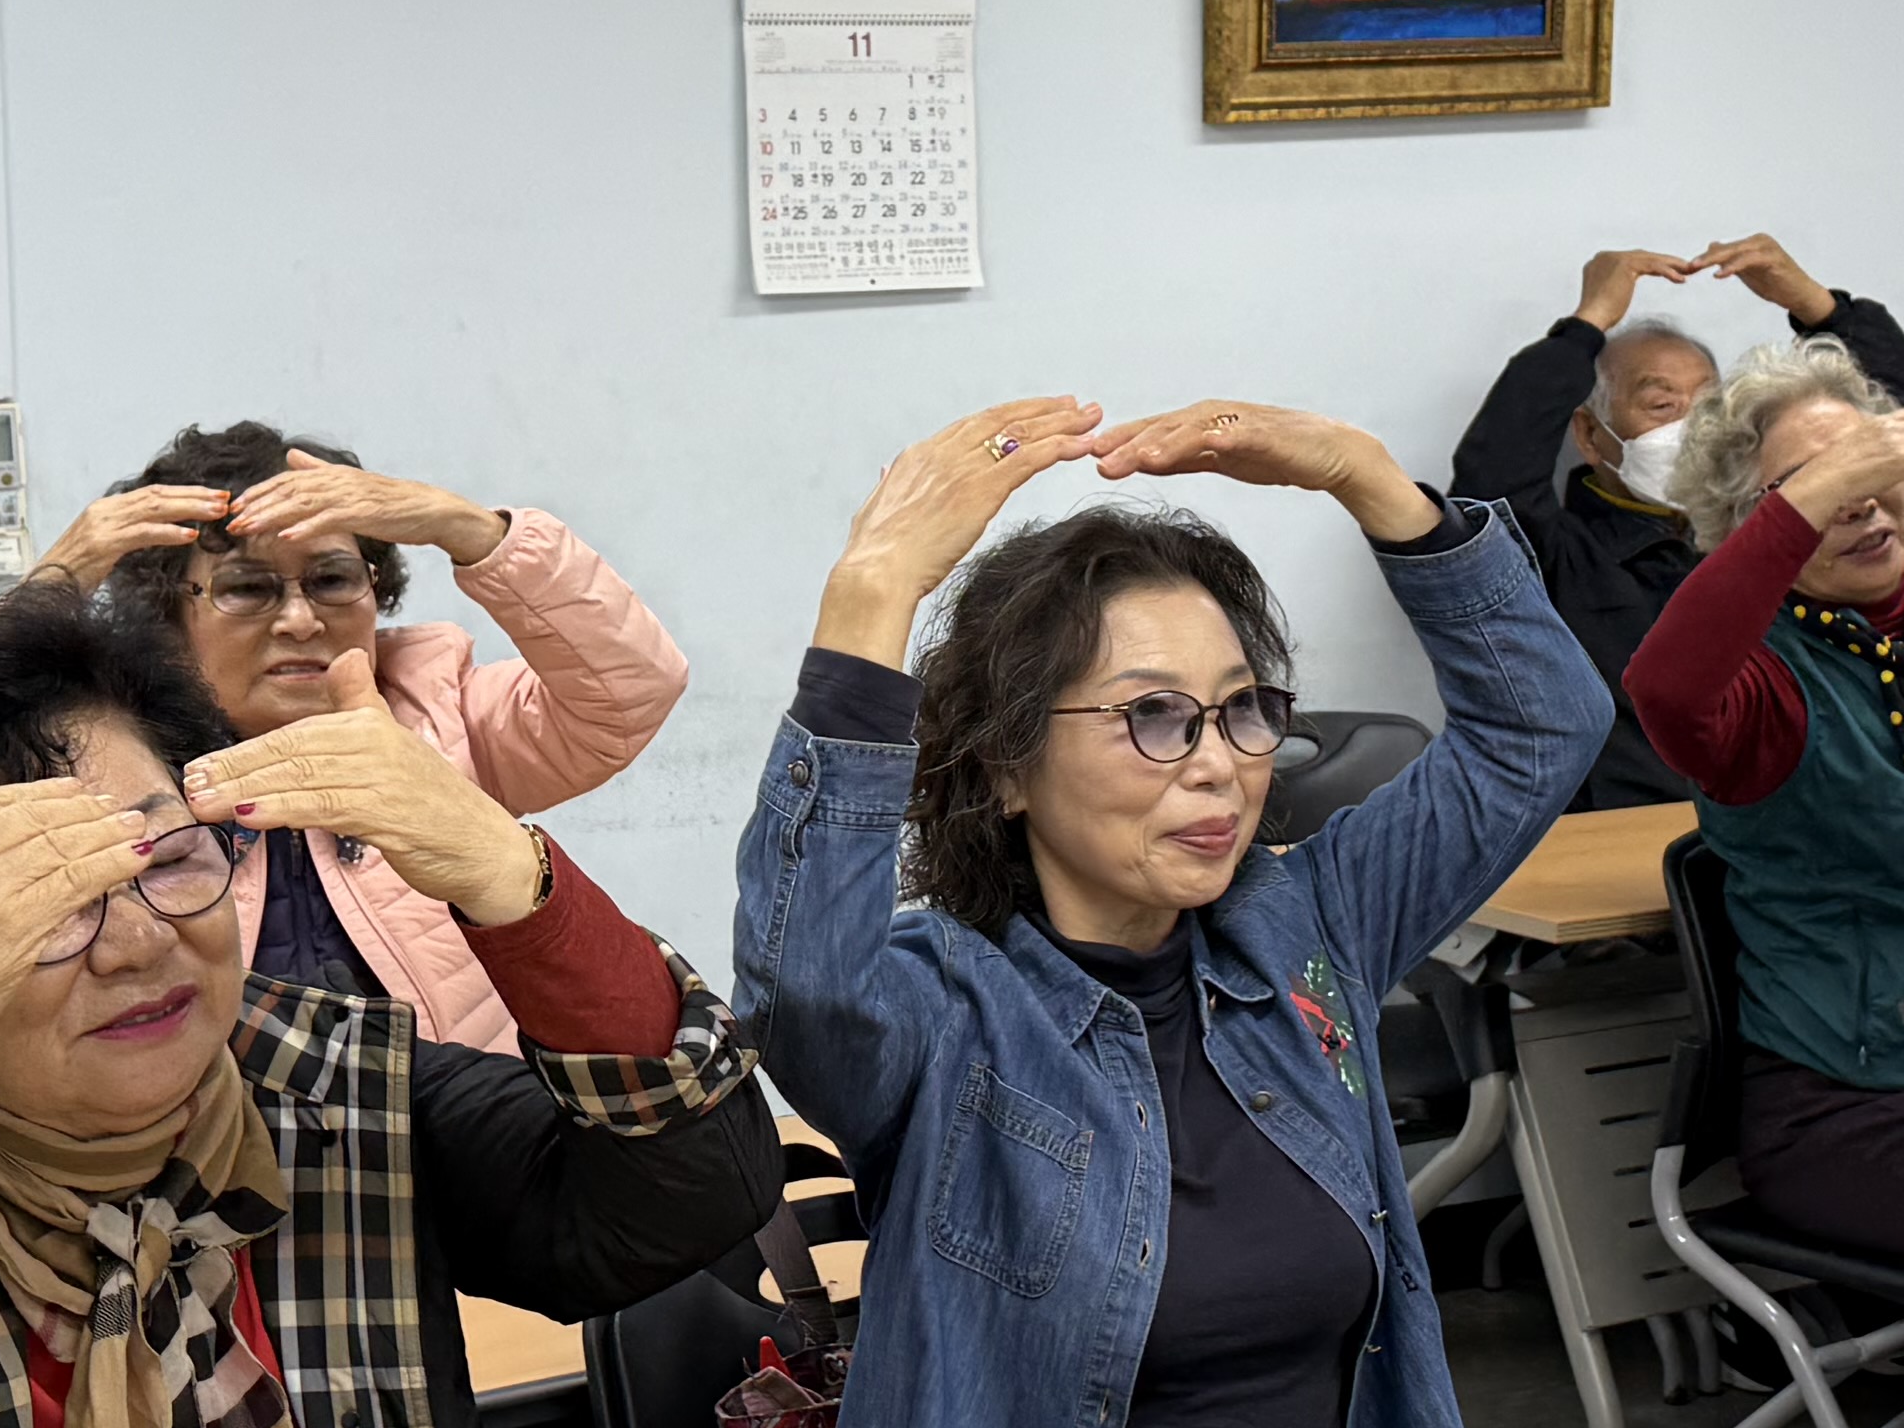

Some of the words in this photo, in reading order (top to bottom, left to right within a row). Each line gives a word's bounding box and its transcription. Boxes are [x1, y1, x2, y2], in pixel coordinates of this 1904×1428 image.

[848, 32, 872, 57] 11
[908, 74, 914, 88] 1
[938, 74, 946, 88] 2
[759, 108, 768, 123] 3
[788, 109, 797, 121] 4
[819, 109, 827, 122] 5
[849, 108, 857, 121] 6
[879, 108, 887, 121] 7
[908, 108, 917, 121] 8
[938, 108, 947, 120] 9
[759, 141, 773, 155] 10
[790, 141, 801, 154] 11
[820, 141, 833, 154] 12
[850, 140, 862, 154] 13
[879, 140, 892, 153] 14
[910, 140, 922, 153] 15
[939, 140, 951, 153] 16
[761, 175, 773, 188] 17
[792, 174, 804, 187] 18
[821, 174, 834, 187] 19
[851, 173, 867, 186] 20
[881, 173, 894, 185] 21
[910, 172, 925, 185] 22
[939, 171, 954, 184] 23
[762, 207, 778, 221] 24
[792, 206, 808, 220] 25
[822, 205, 838, 219] 26
[852, 204, 867, 218] 27
[882, 204, 897, 218] 28
[911, 203, 926, 217] 29
[940, 203, 956, 216] 30
